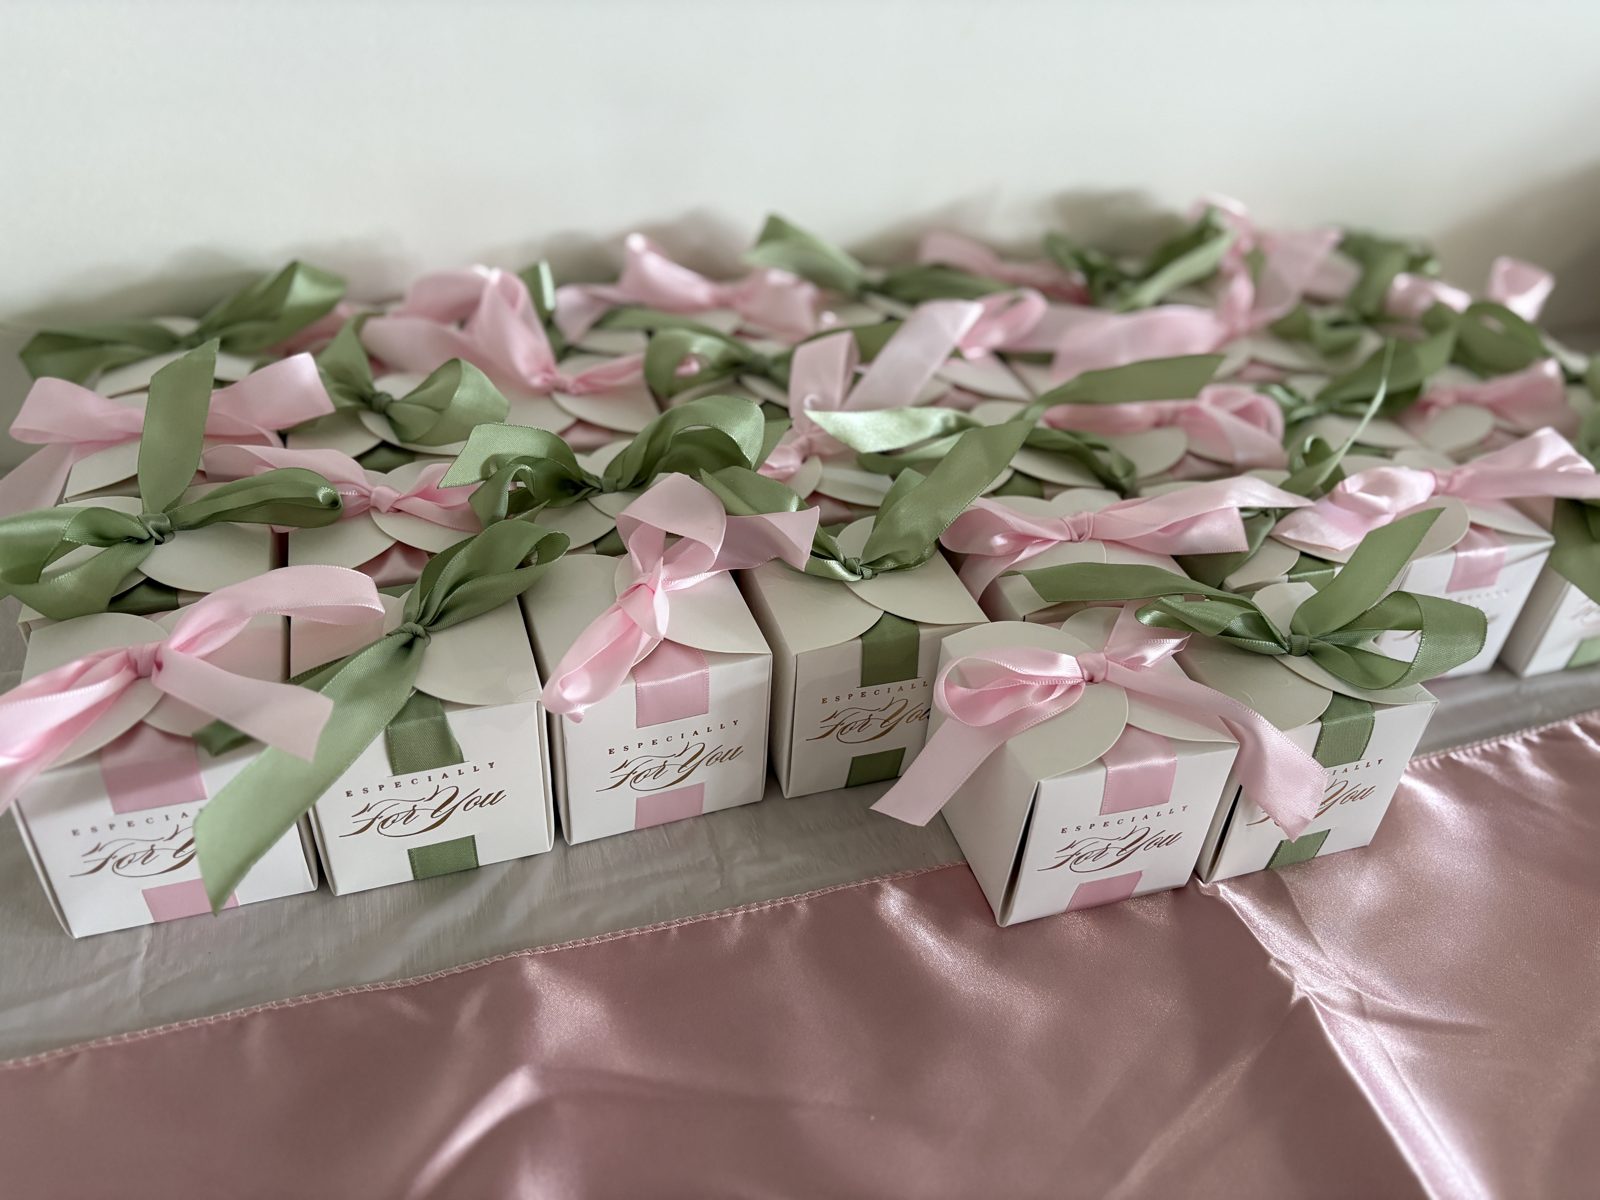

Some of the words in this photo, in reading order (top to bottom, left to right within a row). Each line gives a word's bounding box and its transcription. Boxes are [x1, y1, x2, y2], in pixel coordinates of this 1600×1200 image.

[821, 680, 929, 704] ESPECIALL
[608, 719, 739, 755] ESPECIALLY
[806, 707, 881, 744] For
[345, 761, 496, 798] ESPECIALLY
[596, 754, 676, 792] For
[674, 740, 744, 791] You
[70, 808, 203, 837] ESPECIA
[338, 797, 425, 838] For
[420, 784, 508, 838] You
[1060, 804, 1188, 834] ESPECIALLY
[69, 836, 165, 878] For
[1037, 836, 1121, 874] For
[1117, 825, 1184, 872] You
